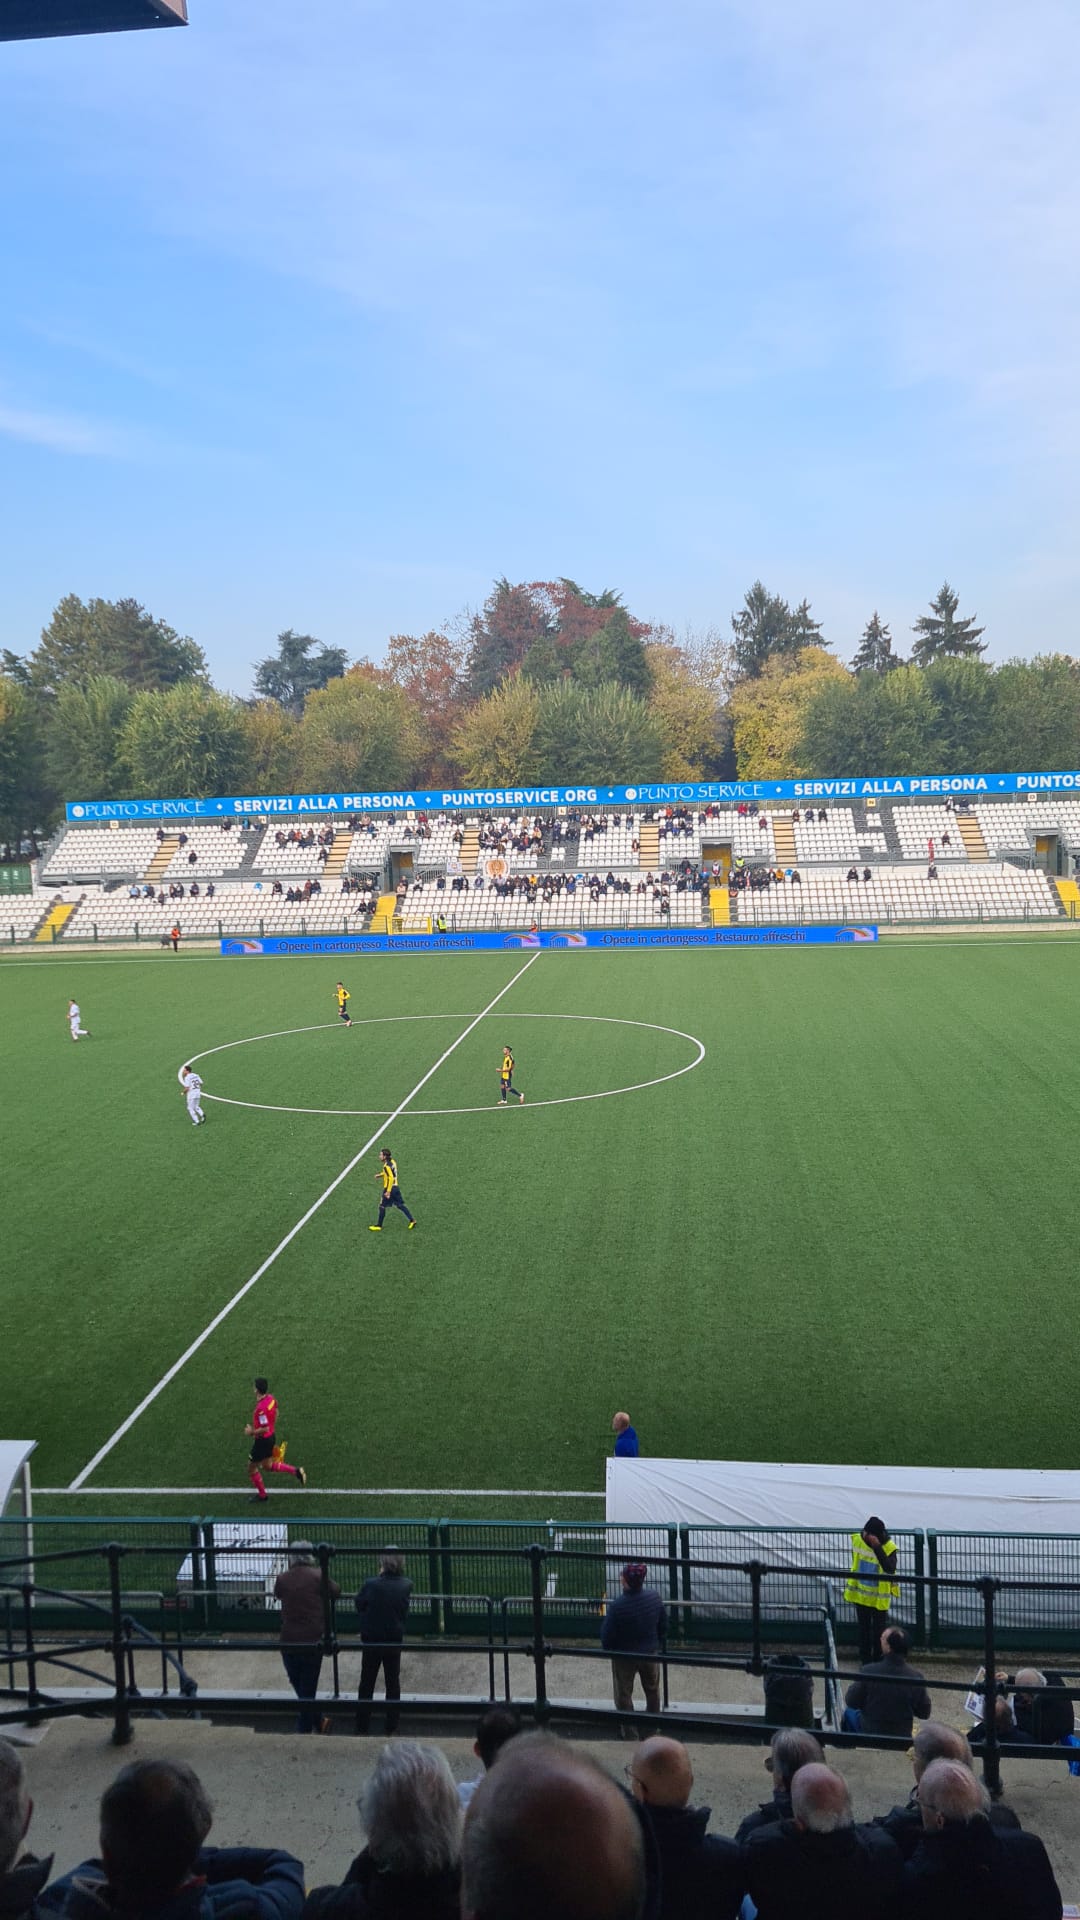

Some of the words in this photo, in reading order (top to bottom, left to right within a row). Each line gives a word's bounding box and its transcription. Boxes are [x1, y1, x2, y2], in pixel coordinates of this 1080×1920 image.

[638, 786, 694, 800] PUNTO
[698, 783, 765, 799] SERVICE
[793, 781, 856, 796] SERVIZI
[861, 779, 905, 794] ALLA
[909, 777, 988, 792] PERSONA
[233, 798, 293, 813] SERVIZI
[298, 797, 338, 811] ALLA
[343, 795, 416, 809] PERSONA
[441, 788, 597, 806] PUNTOSERVICE.ORG
[85, 803, 139, 817] PUNTO
[142, 801, 206, 815] SERVICE
[276, 941, 310, 953] -Opere
[312, 940, 322, 950] in
[324, 940, 382, 952] cartongesso
[384, 938, 431, 949] -Restauro
[433, 936, 475, 947] affreschi
[599, 934, 635, 946] -Opere
[637, 933, 648, 944] in
[650, 933, 709, 945] cartongesso
[711, 932, 760, 943] -Restauro
[762, 930, 805, 941] affreschi
